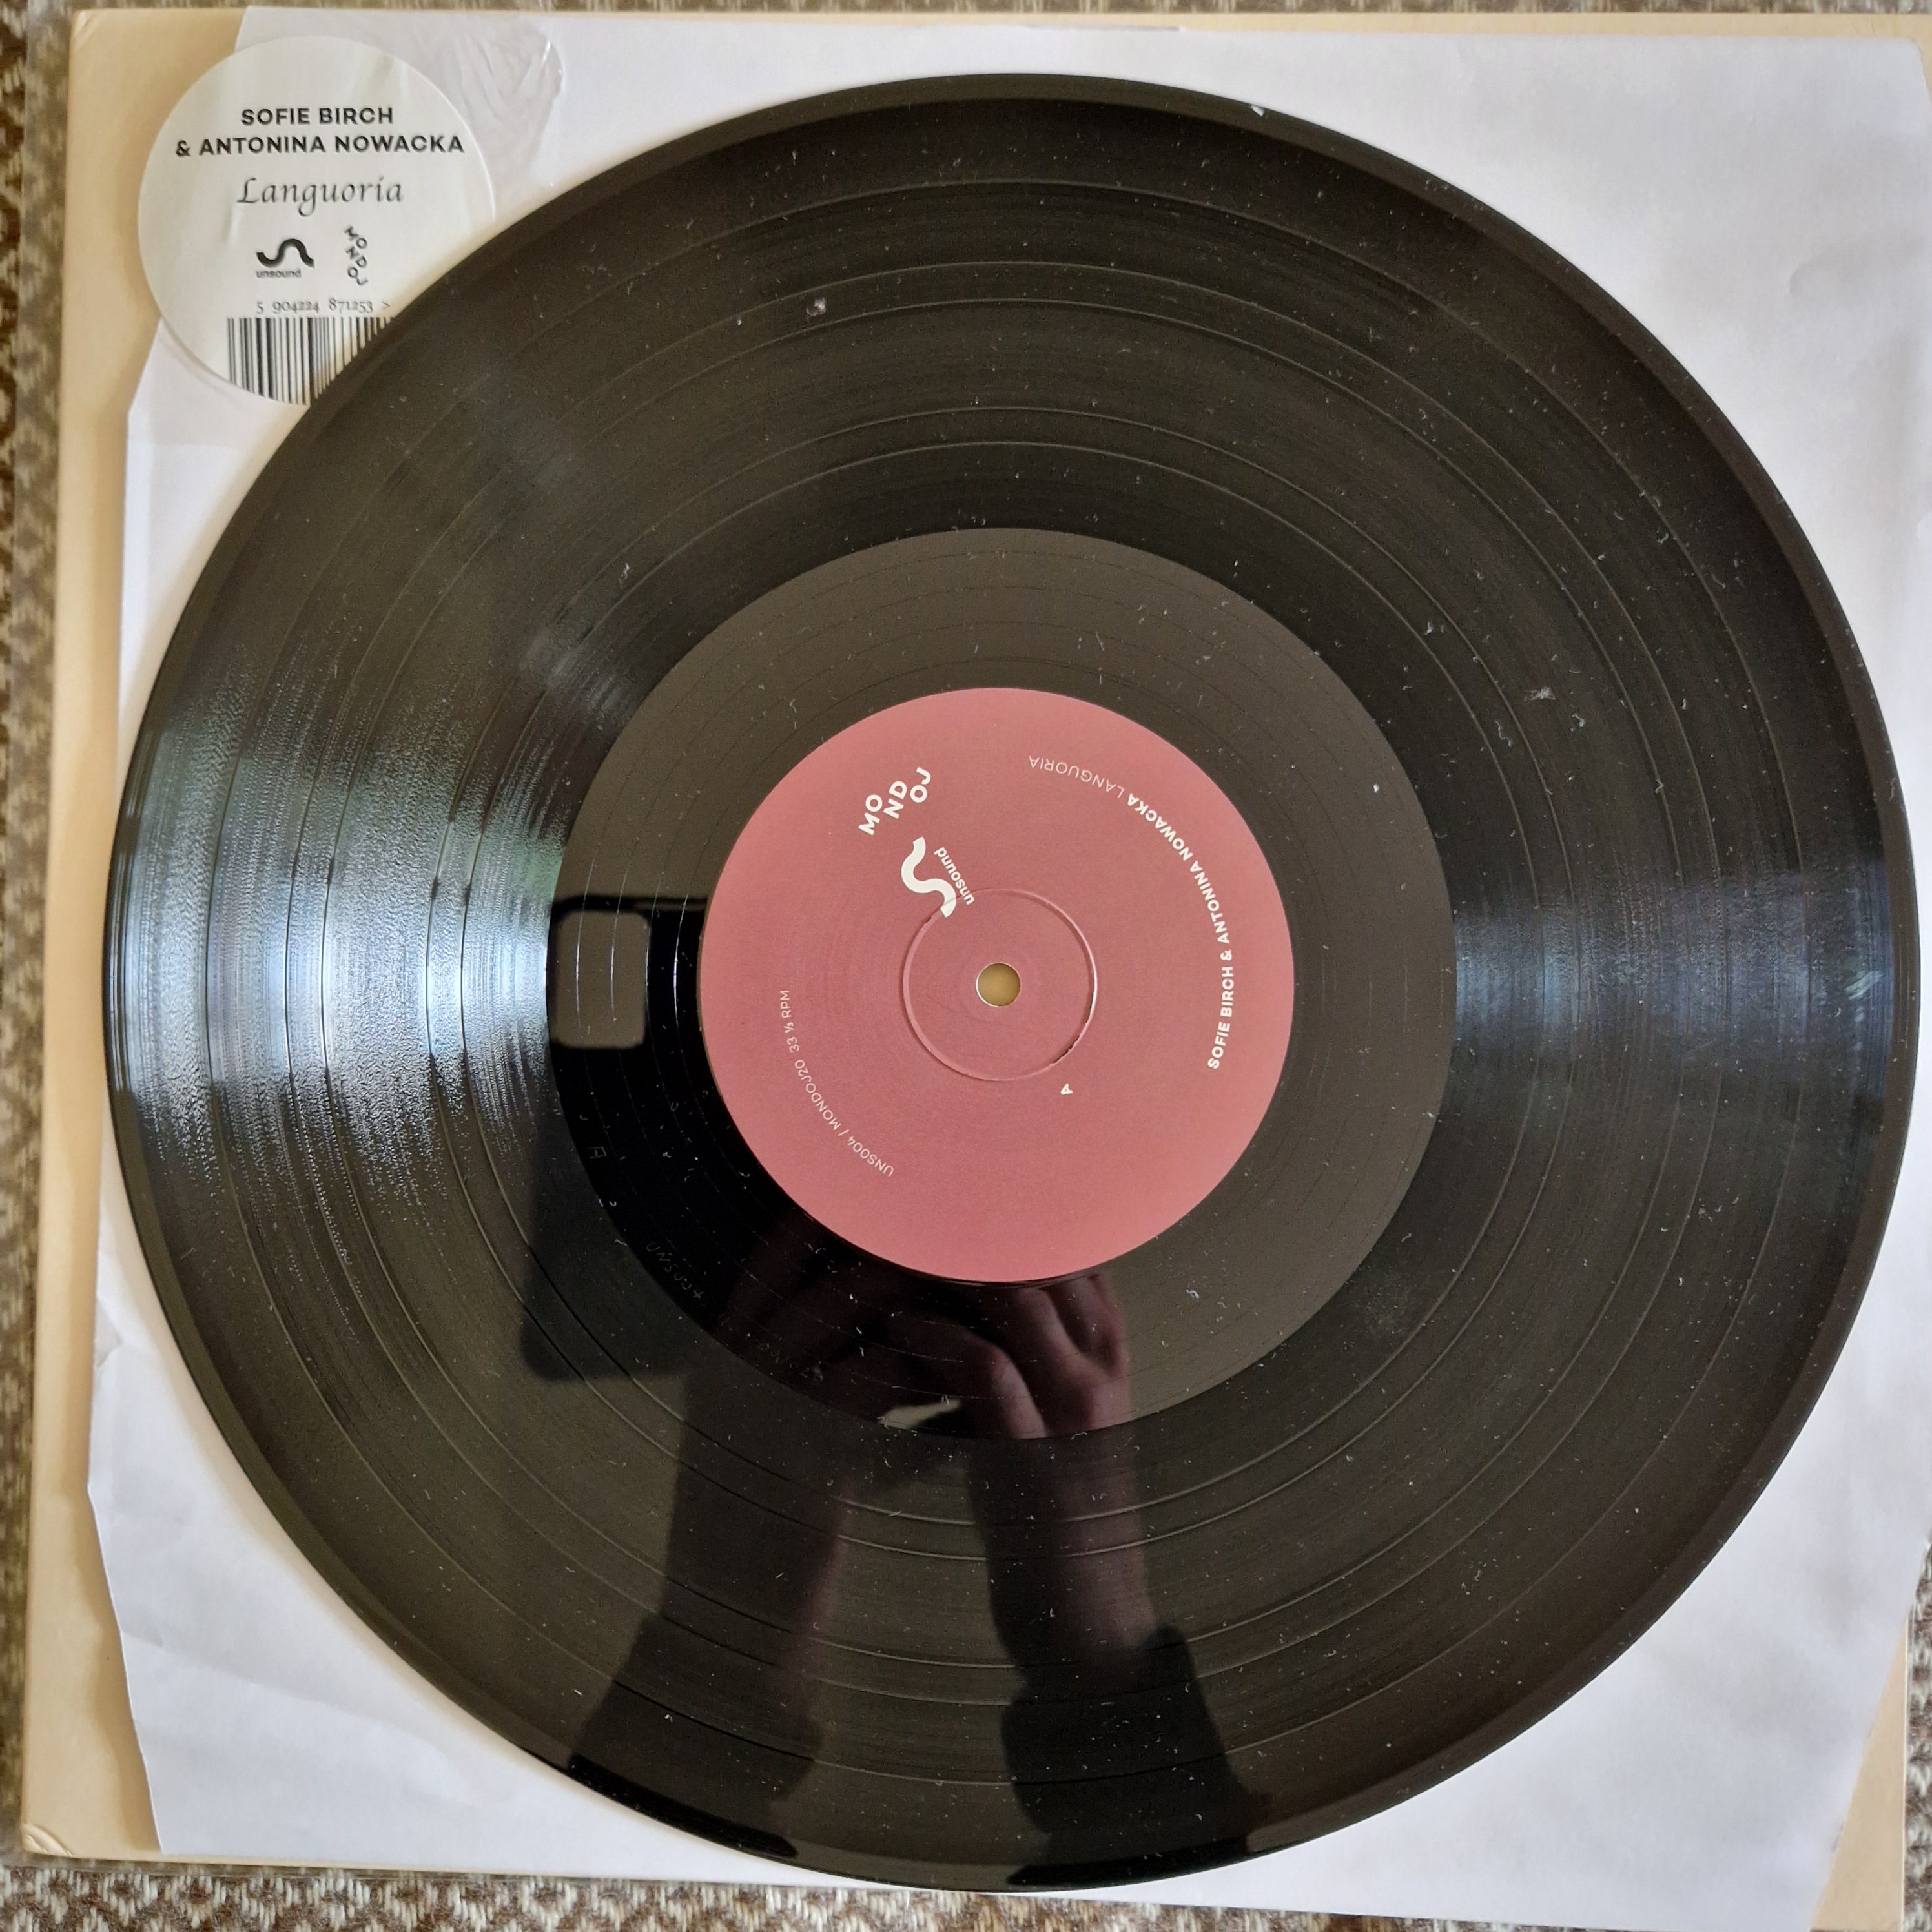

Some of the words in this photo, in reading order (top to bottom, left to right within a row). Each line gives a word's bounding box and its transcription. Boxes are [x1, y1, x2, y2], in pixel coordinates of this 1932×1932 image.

[240, 108, 311, 127] SOFIE
[318, 107, 393, 125] BIRCH
[175, 139, 192, 158] &
[198, 136, 327, 156] ANTONINA
[334, 134, 465, 153] NOWACKA
[256, 269, 302, 278] unsound
[256, 301, 264, 314] 5
[272, 300, 320, 314] 904224
[329, 298, 373, 314] 871253
[1029, 755, 1125, 799] LANGUORIA
[1127, 793, 1194, 861] NOWACKA
[933, 847, 976, 905] unsound
[1189, 860, 1230, 944] ANTONINA
[1220, 949, 1233, 961] &
[779, 990, 792, 1018] RPM
[1220, 966, 1235, 1018] BIRCH
[786, 1036, 800, 1053] 33
[1207, 1021, 1231, 1069] SOFIE
[794, 1060, 841, 1131] MONDOJ20
[1060, 1083, 1073, 1095] A
[847, 1136, 894, 1177] UNS004
